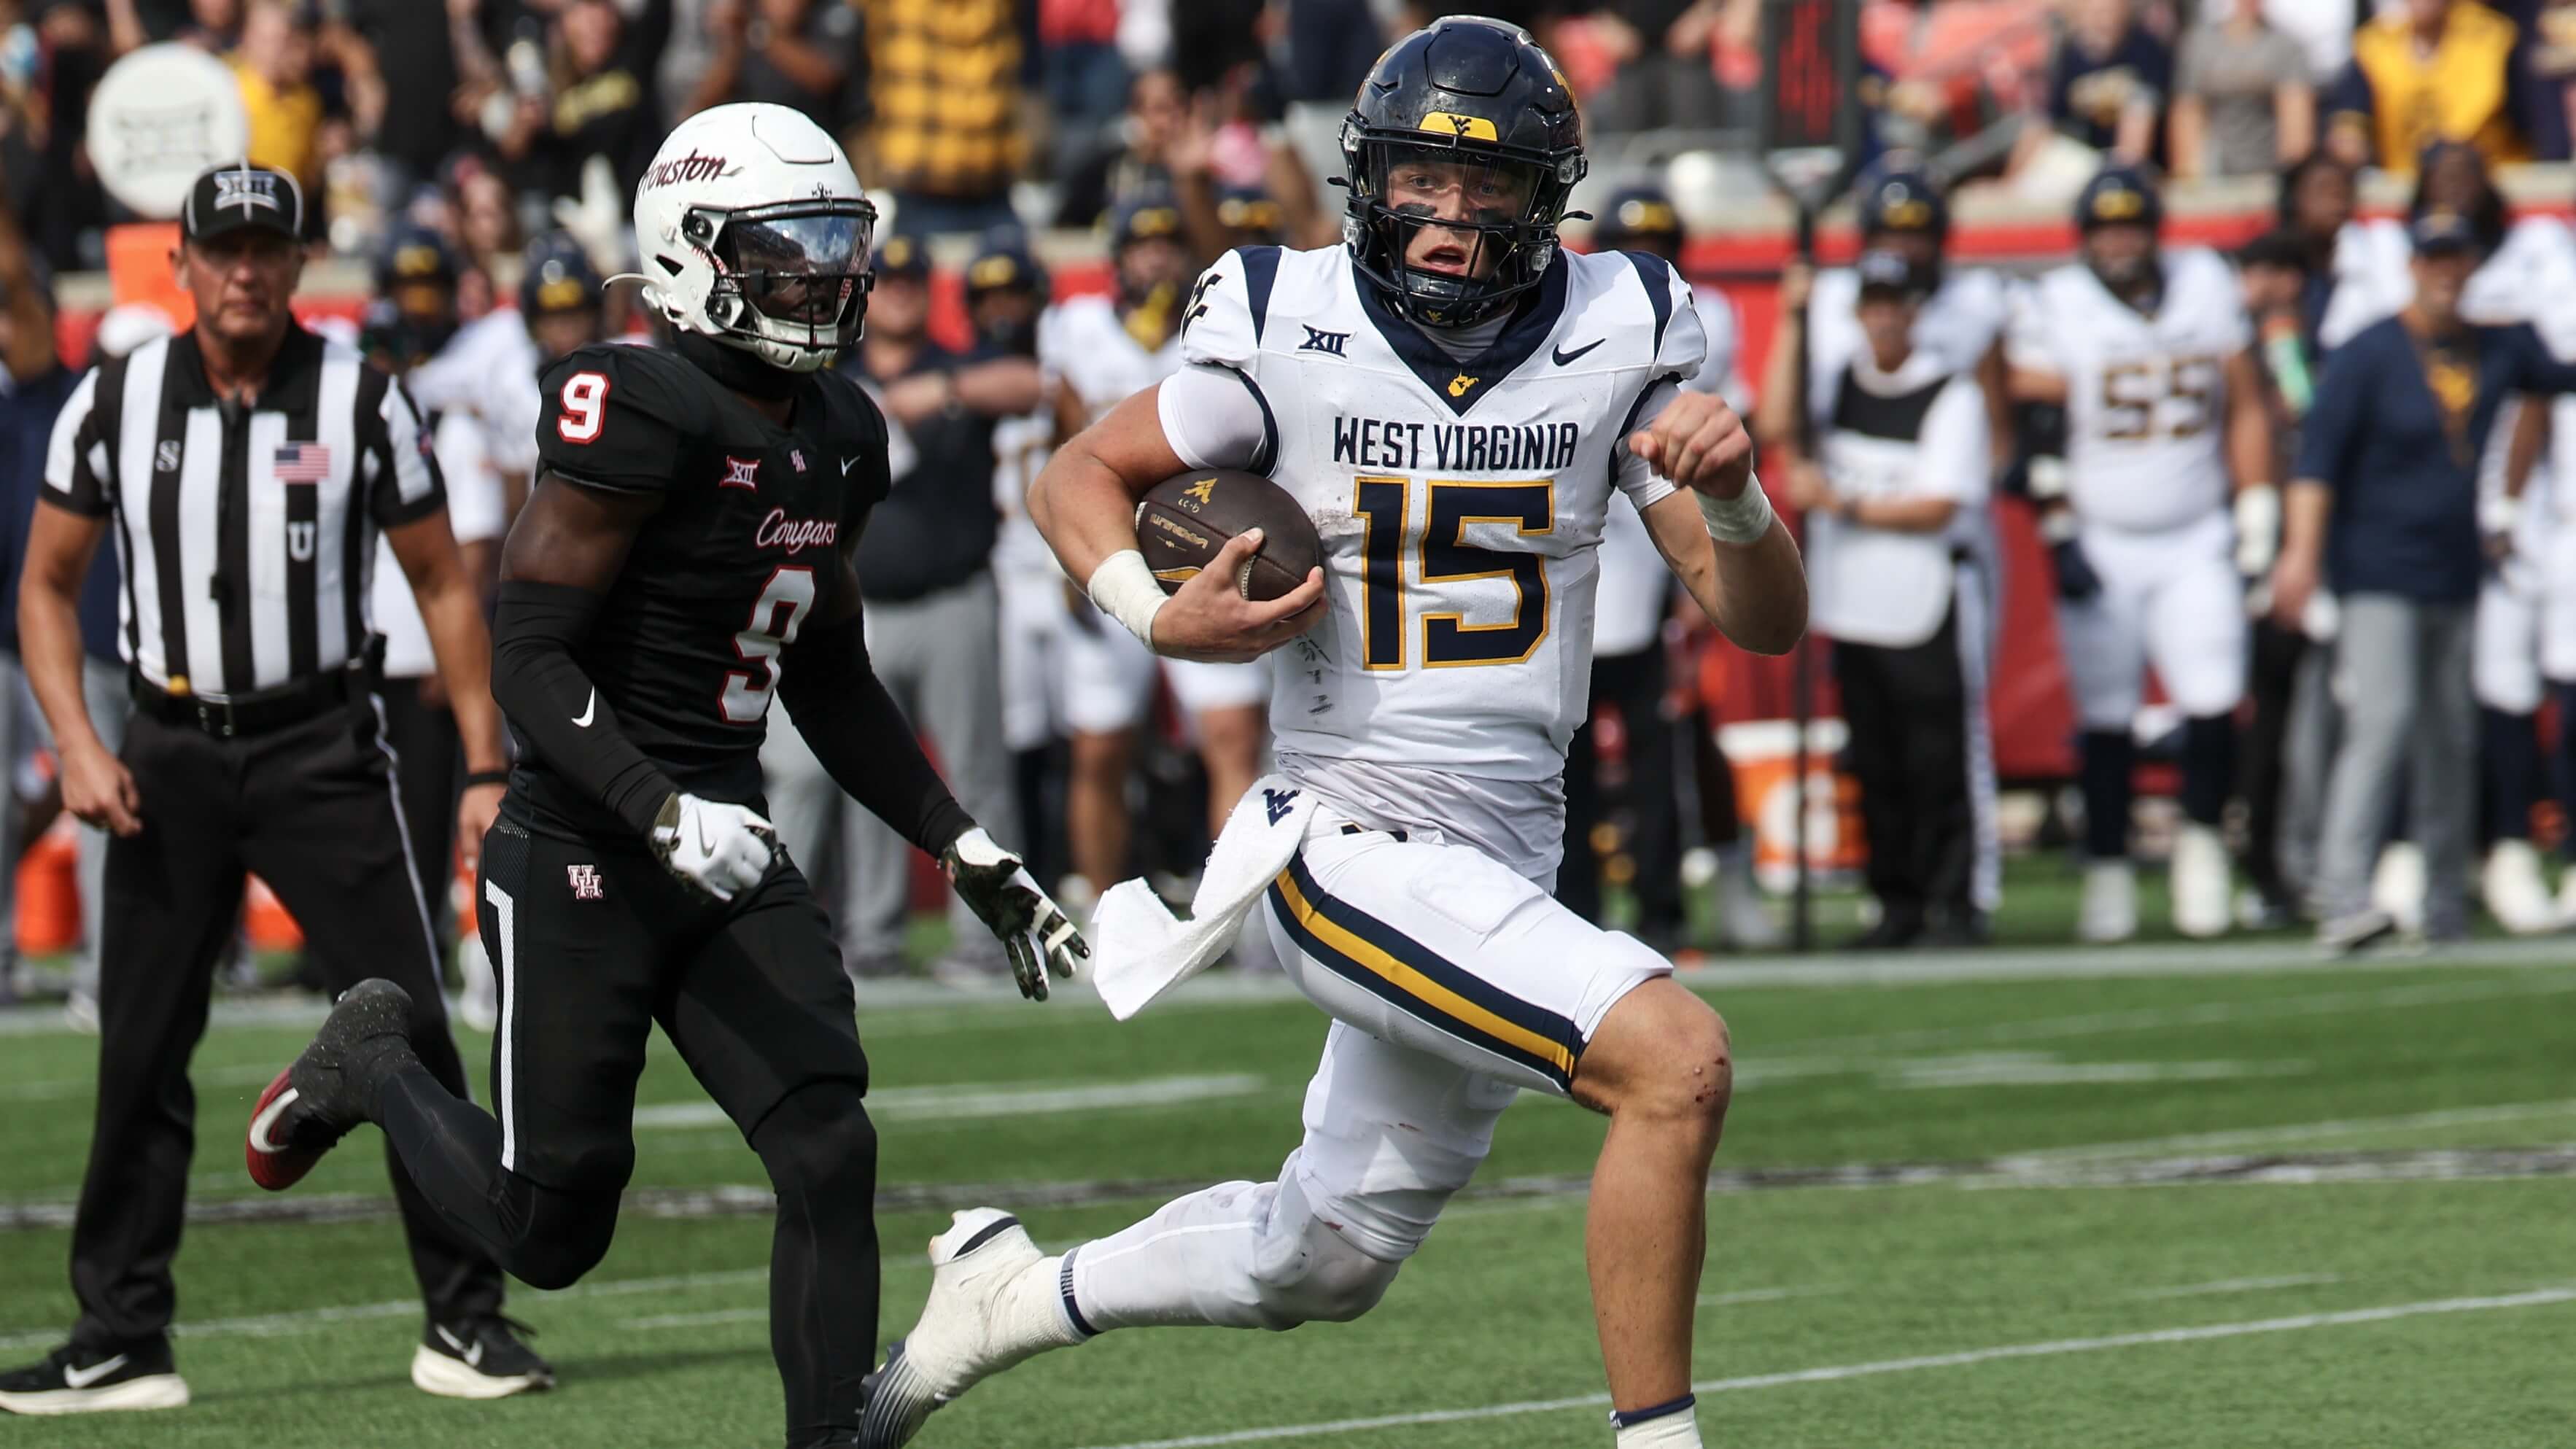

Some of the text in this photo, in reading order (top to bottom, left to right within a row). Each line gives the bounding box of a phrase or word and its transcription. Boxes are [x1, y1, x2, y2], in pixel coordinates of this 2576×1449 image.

[1298, 323, 1353, 358] XII
[557, 370, 610, 445] 9
[155, 439, 182, 473] S
[1333, 416, 1578, 470] WEST VIRGINIA
[720, 457, 760, 491] XII
[287, 521, 316, 561] U
[756, 505, 837, 555] Cougars
[1353, 475, 1555, 672] 15
[717, 564, 815, 725] 9
